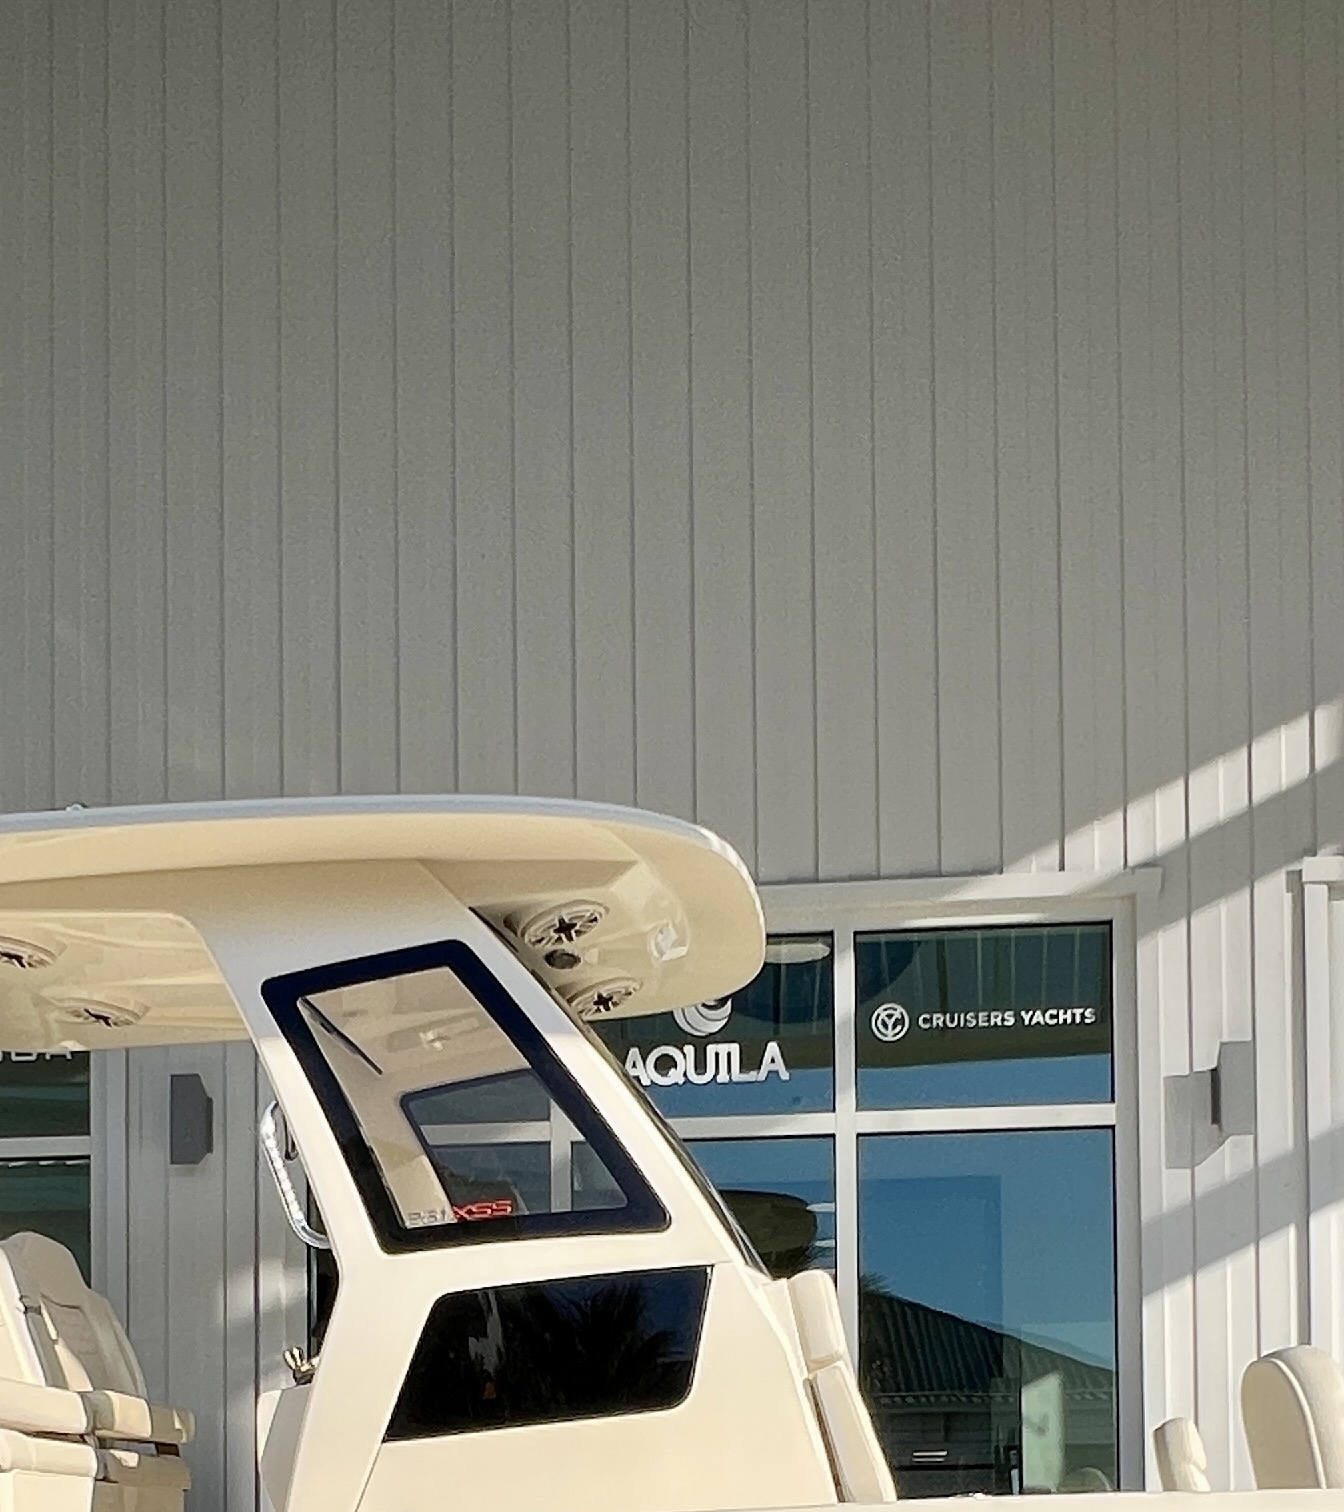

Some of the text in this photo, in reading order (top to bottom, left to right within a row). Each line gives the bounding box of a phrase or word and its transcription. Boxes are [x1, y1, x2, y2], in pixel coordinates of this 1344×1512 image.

[918, 1008, 1096, 1029] CRUISERS YACHTS
[624, 1040, 790, 1087] AQUILA
